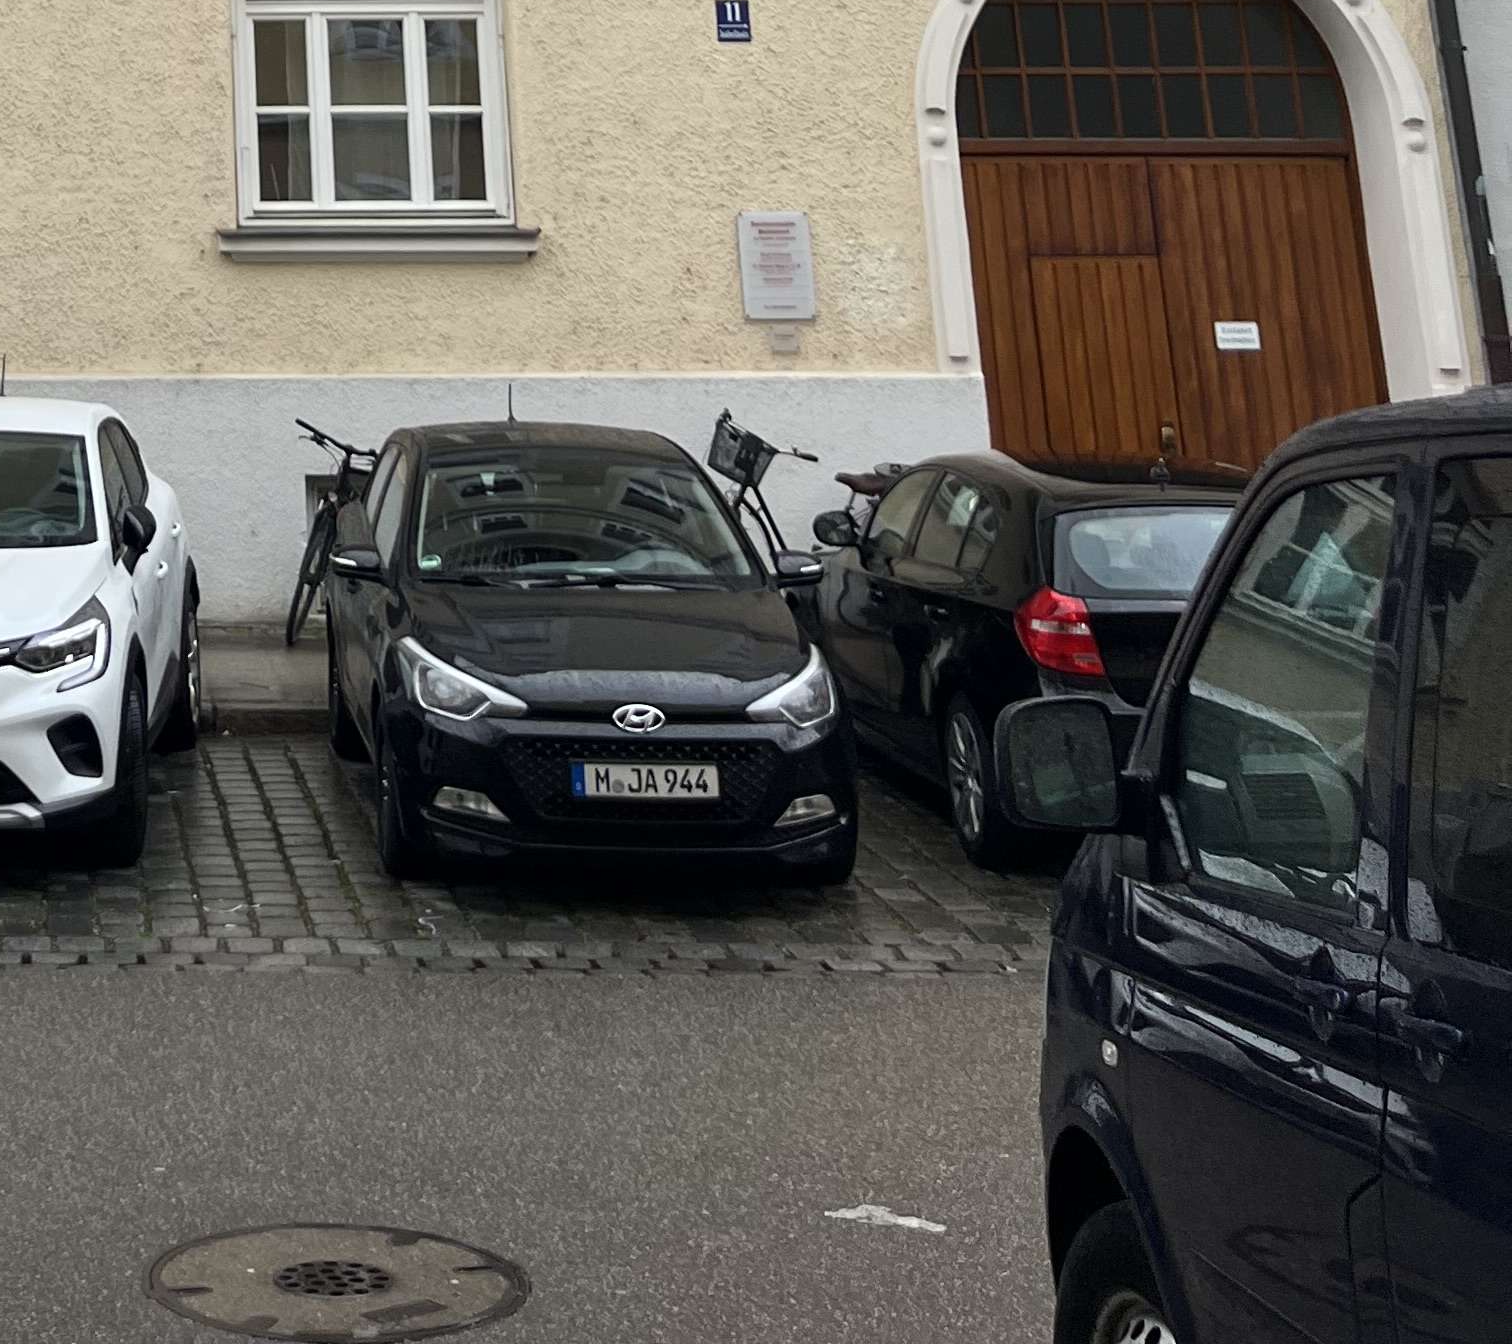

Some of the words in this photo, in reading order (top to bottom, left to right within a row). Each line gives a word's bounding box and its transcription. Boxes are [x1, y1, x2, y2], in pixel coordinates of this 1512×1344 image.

[723, 1, 742, 22] 11
[594, 767, 610, 793] M
[627, 768, 658, 793] JA
[664, 768, 708, 793] 944
